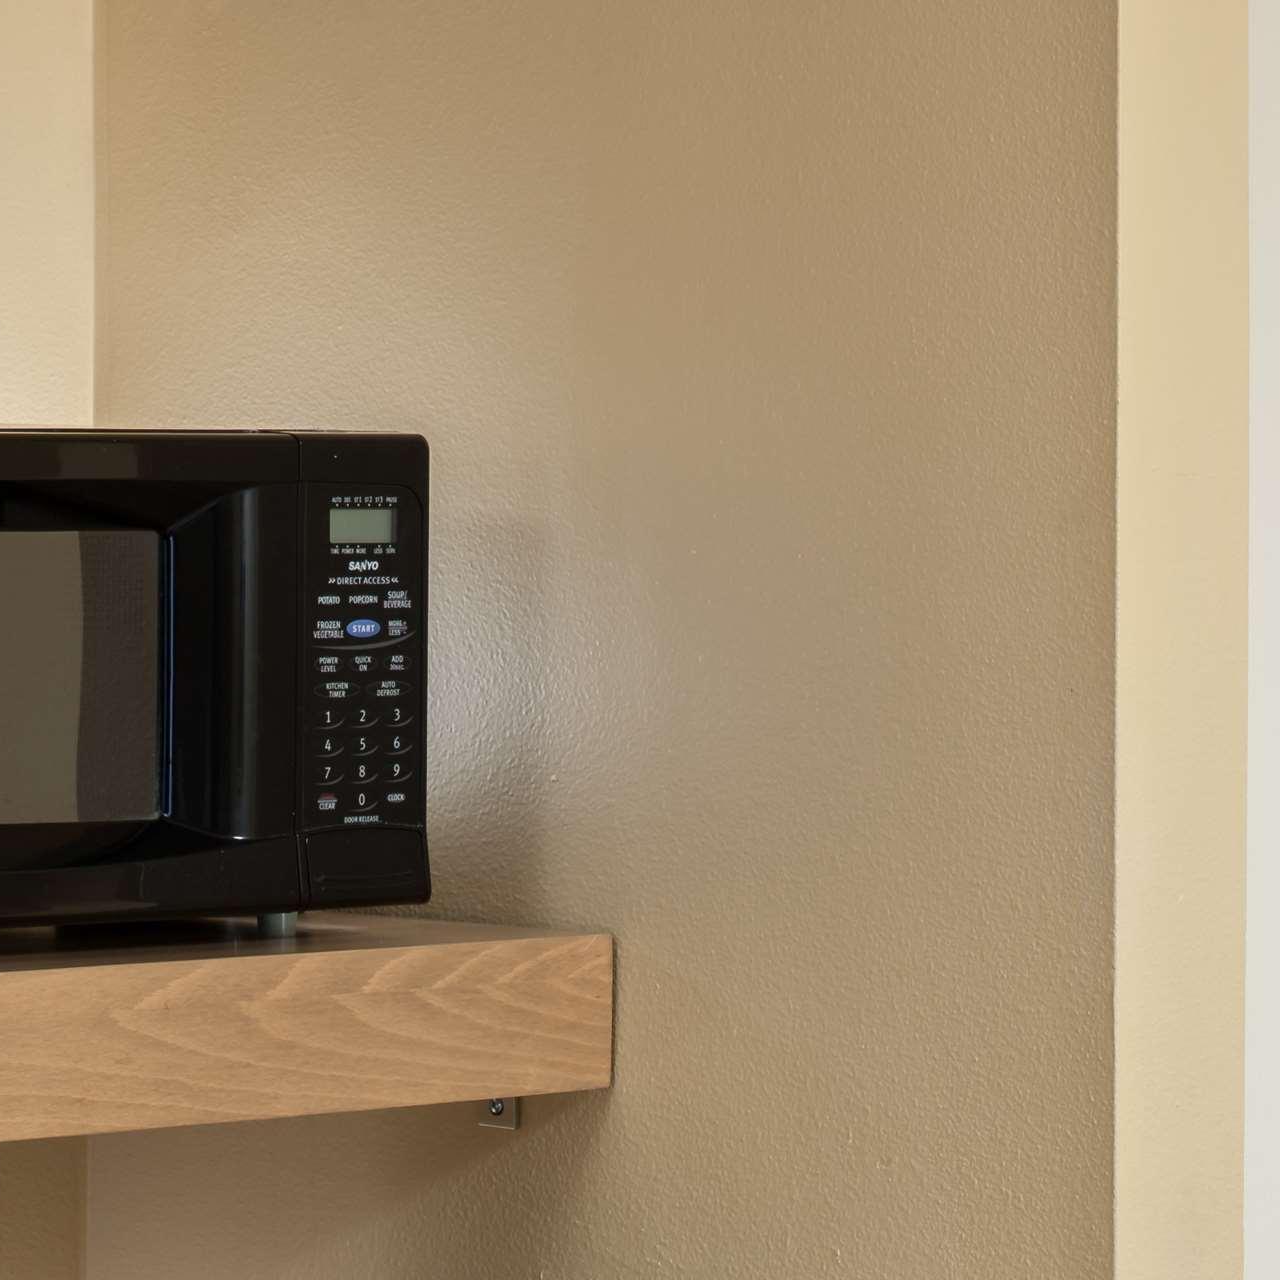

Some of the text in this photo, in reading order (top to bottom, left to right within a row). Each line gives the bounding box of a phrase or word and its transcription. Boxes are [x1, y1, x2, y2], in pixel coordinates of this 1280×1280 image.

[348, 560, 379, 572] SANYO
[336, 576, 391, 585] DIRECT ACCESS
[387, 590, 408, 600] SOUP/
[318, 595, 340, 605] POTATO
[349, 595, 378, 605] POPCORN
[383, 600, 411, 609] BEVERAGE
[317, 621, 341, 629] FROZEN
[352, 624, 375, 633] START
[313, 630, 344, 639] VEGETABLE
[319, 656, 339, 665] POWER
[354, 656, 372, 664] QUICK
[391, 655, 404, 663] ADD
[320, 665, 337, 673] LEVEL
[359, 664, 368, 672] ON
[326, 682, 349, 690] KITCHEN
[381, 680, 396, 689] AUTO
[328, 690, 346, 698] TIMER
[376, 688, 401, 697] DEFROST
[325, 710, 331, 723] 1
[359, 709, 366, 722] 2
[393, 708, 401, 721] 3
[324, 739, 331, 751] 4
[359, 737, 366, 750] 5
[393, 736, 401, 749] 6
[324, 766, 332, 779] 7
[359, 764, 366, 778] 8
[393, 763, 401, 777] 9
[358, 793, 366, 806] 0
[387, 793, 405, 802] CLOCK
[344, 815, 380, 824] DOOR RELEASE
